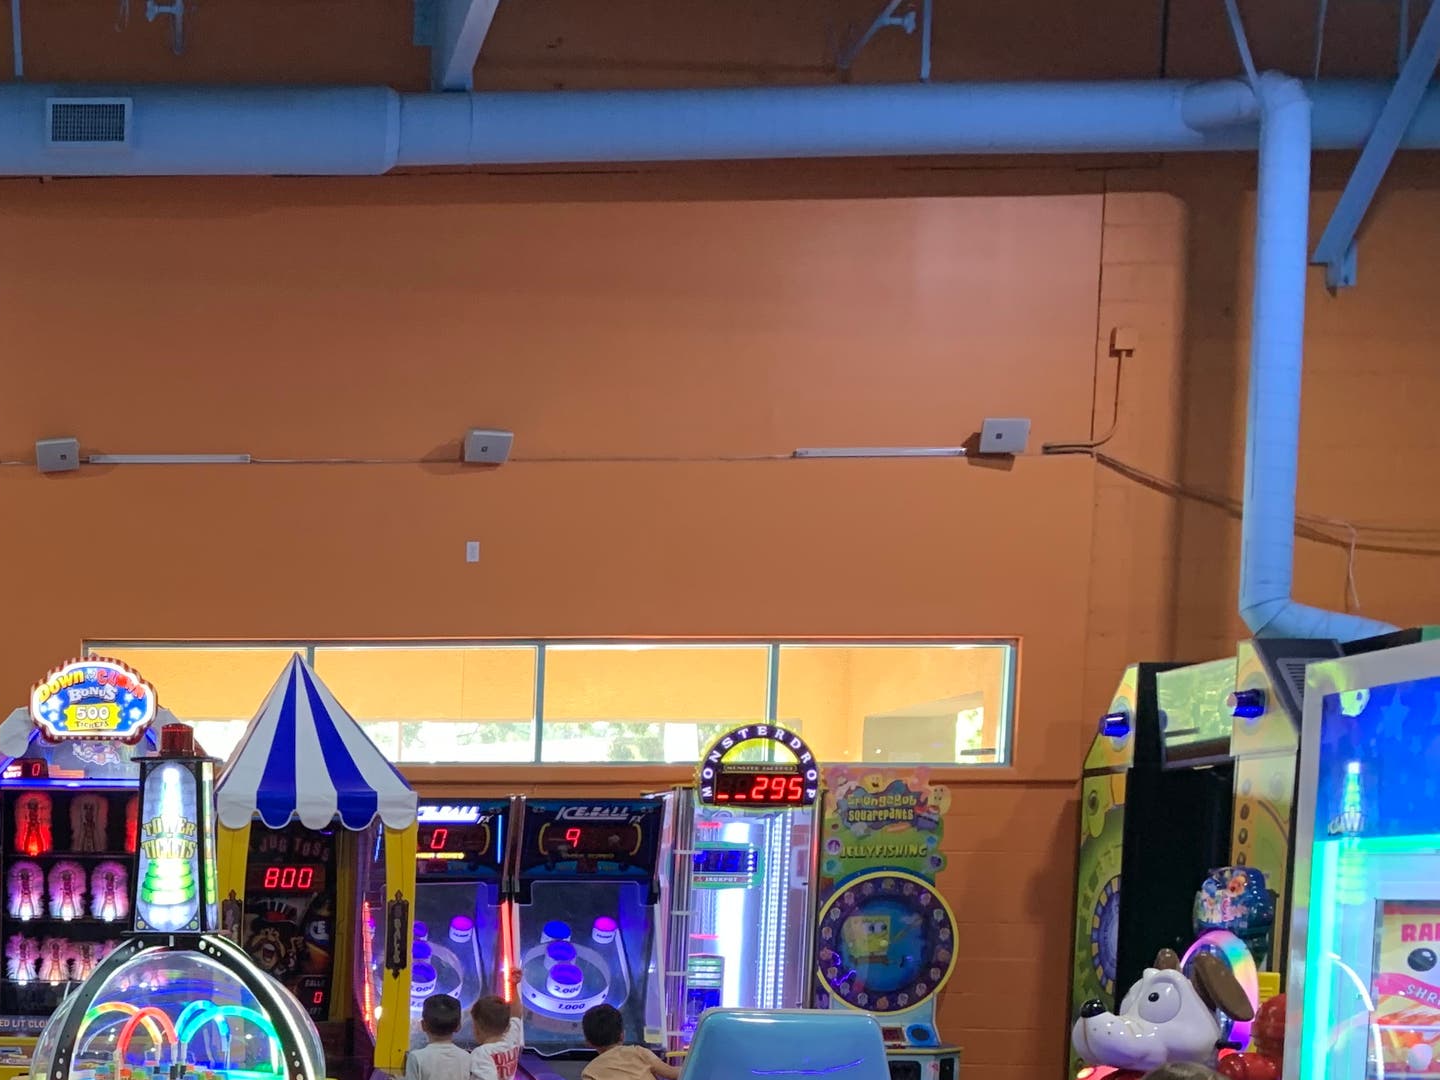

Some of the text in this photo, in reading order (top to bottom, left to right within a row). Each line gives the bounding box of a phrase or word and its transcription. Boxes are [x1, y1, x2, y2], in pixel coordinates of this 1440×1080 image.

[75, 706, 110, 721] 500
[264, 868, 313, 888] 800
[12, 1019, 27, 1028] LIT
